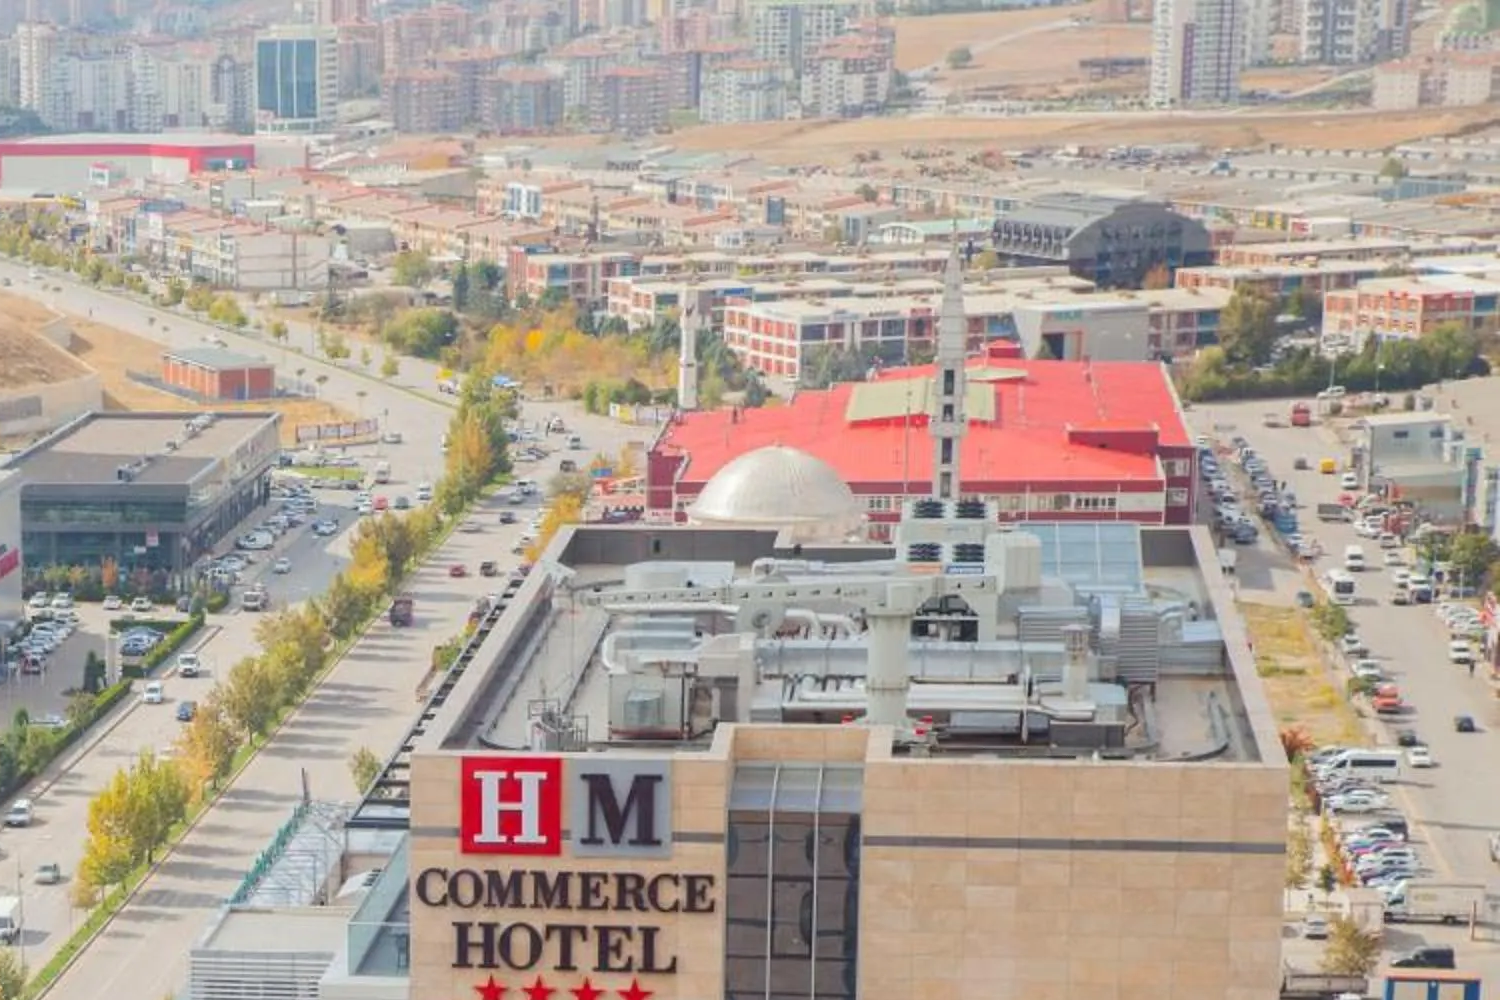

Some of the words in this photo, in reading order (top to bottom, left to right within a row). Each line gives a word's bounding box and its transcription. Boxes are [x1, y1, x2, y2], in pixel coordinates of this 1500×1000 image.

[473, 770, 547, 845] H
[580, 773, 663, 846] M
[415, 867, 716, 914] COMMERCE
[451, 921, 677, 974] HOTEL
